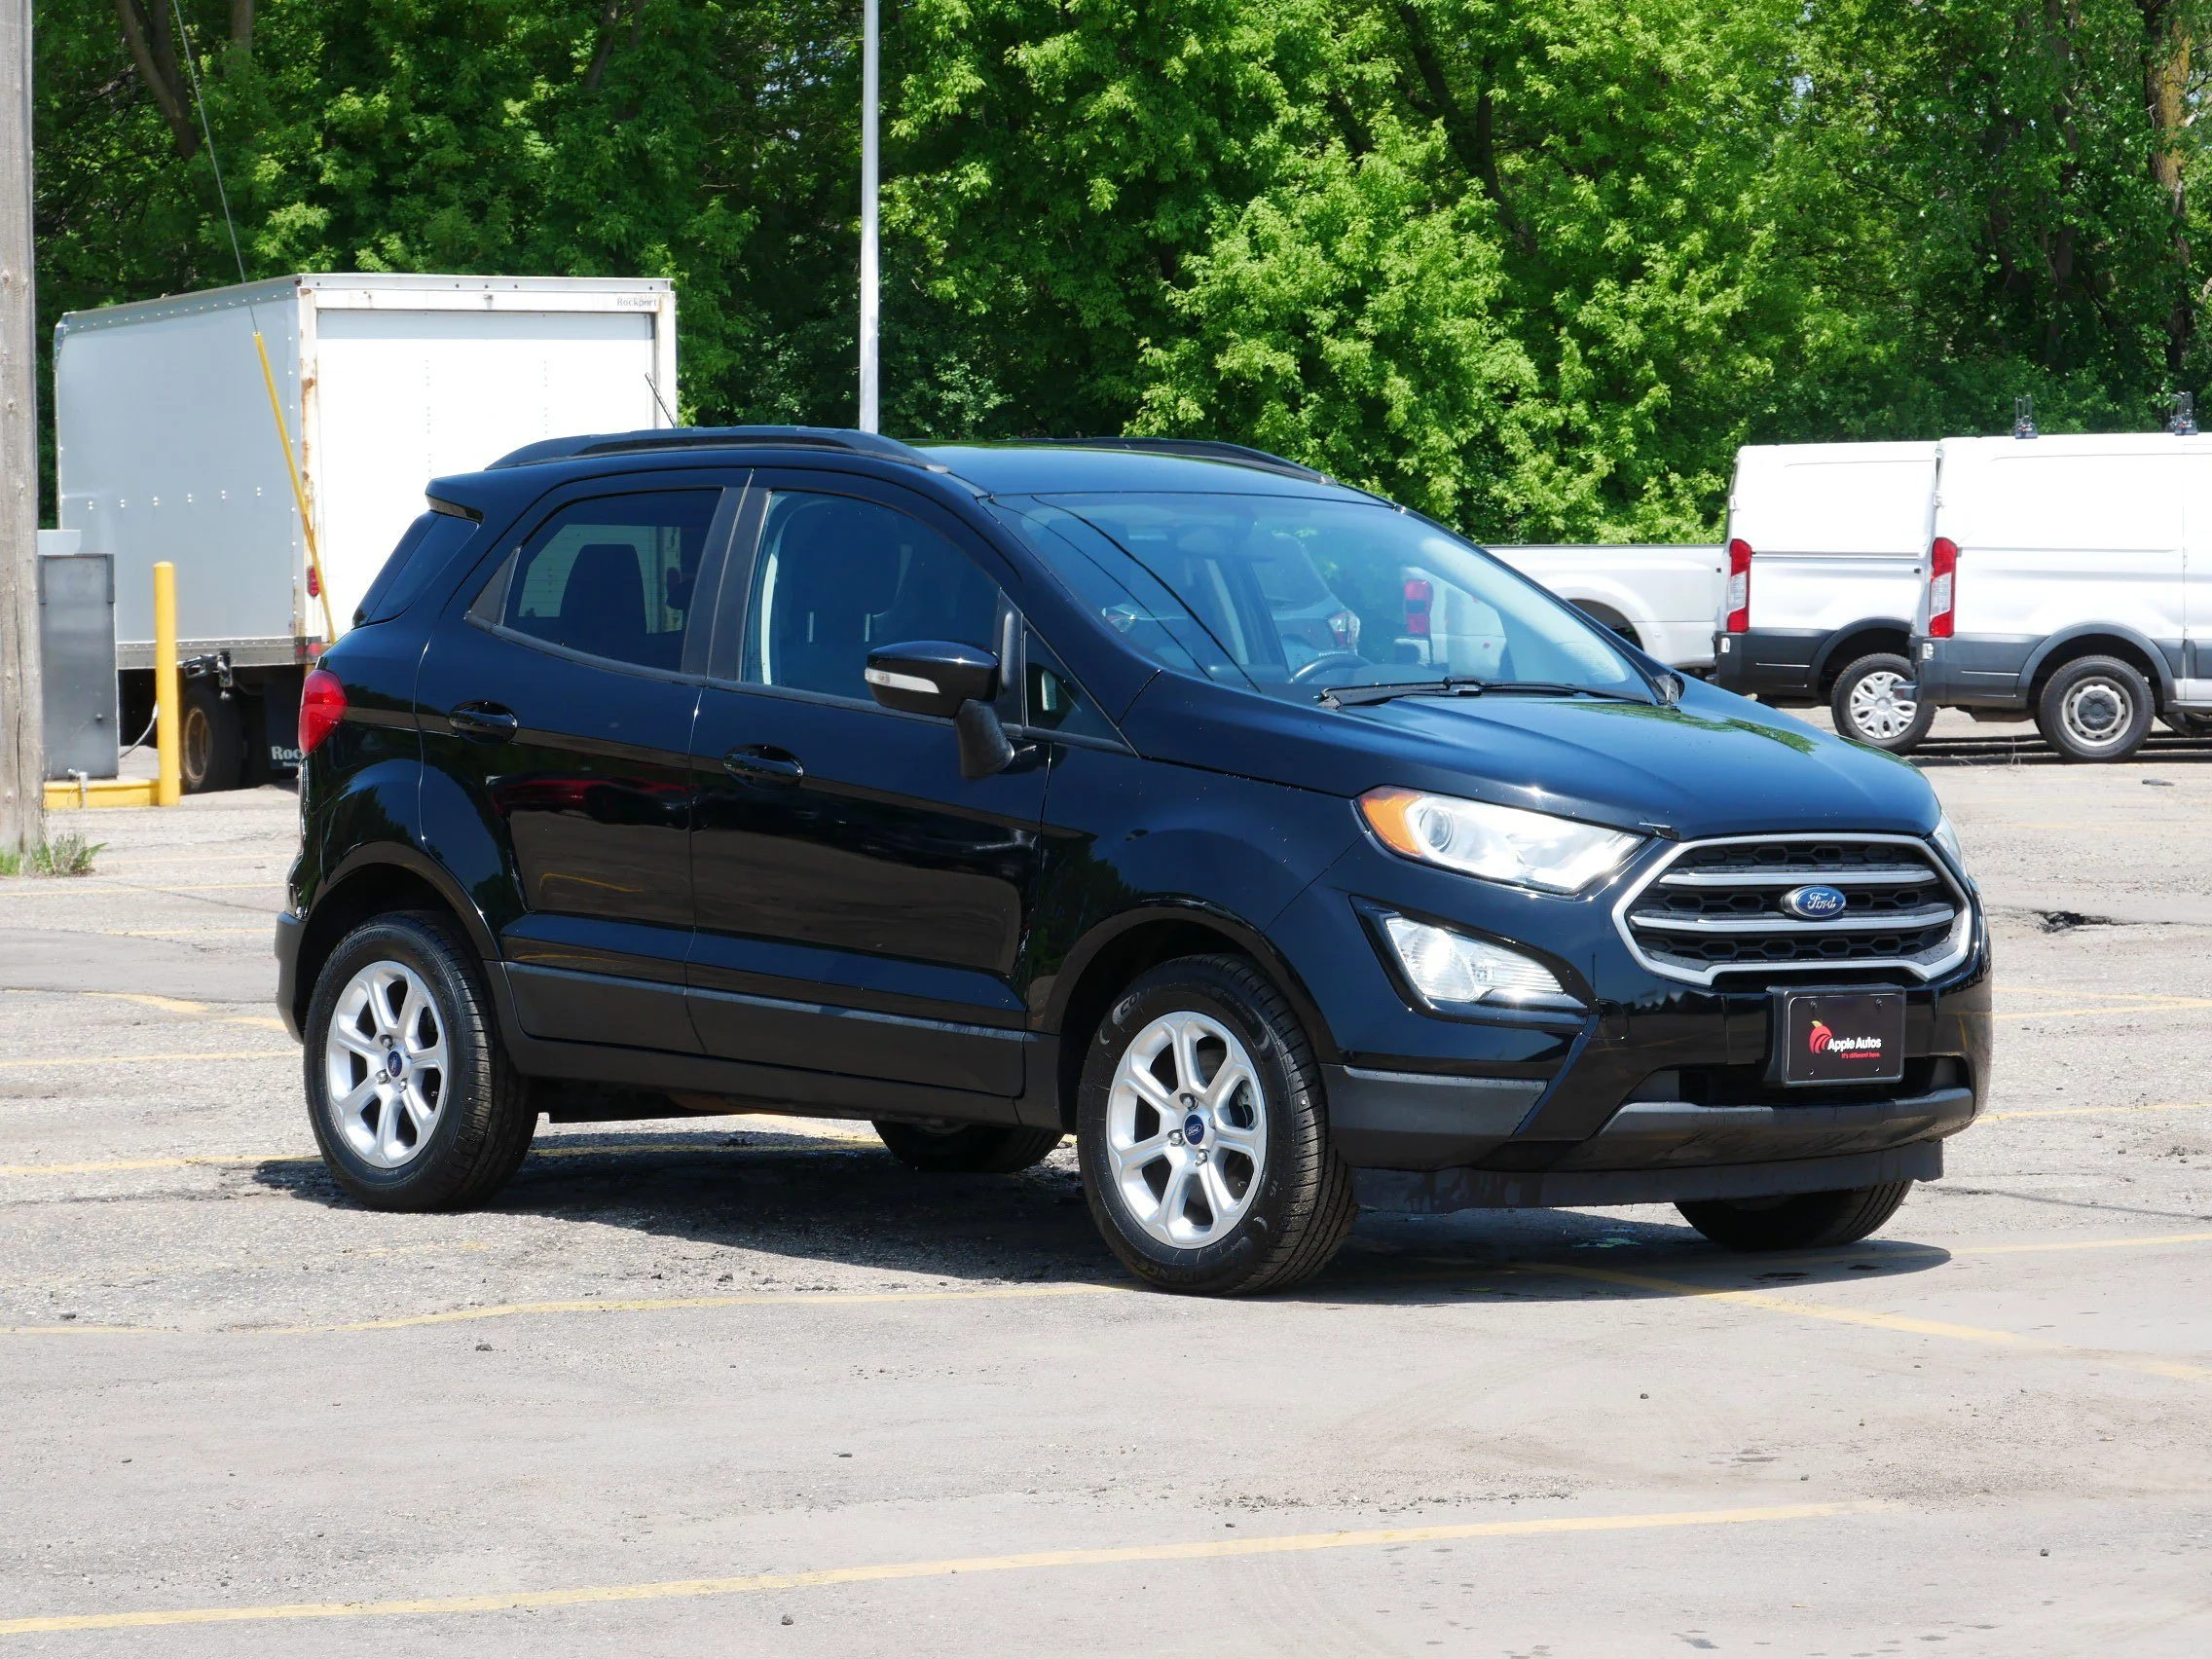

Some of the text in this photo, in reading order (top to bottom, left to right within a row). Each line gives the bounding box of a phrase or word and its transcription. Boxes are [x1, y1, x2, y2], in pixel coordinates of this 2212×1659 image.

[616, 296, 657, 308] Rockport
[1807, 892, 1837, 909] Ford
[1827, 1036, 1882, 1052] Apple Autos
